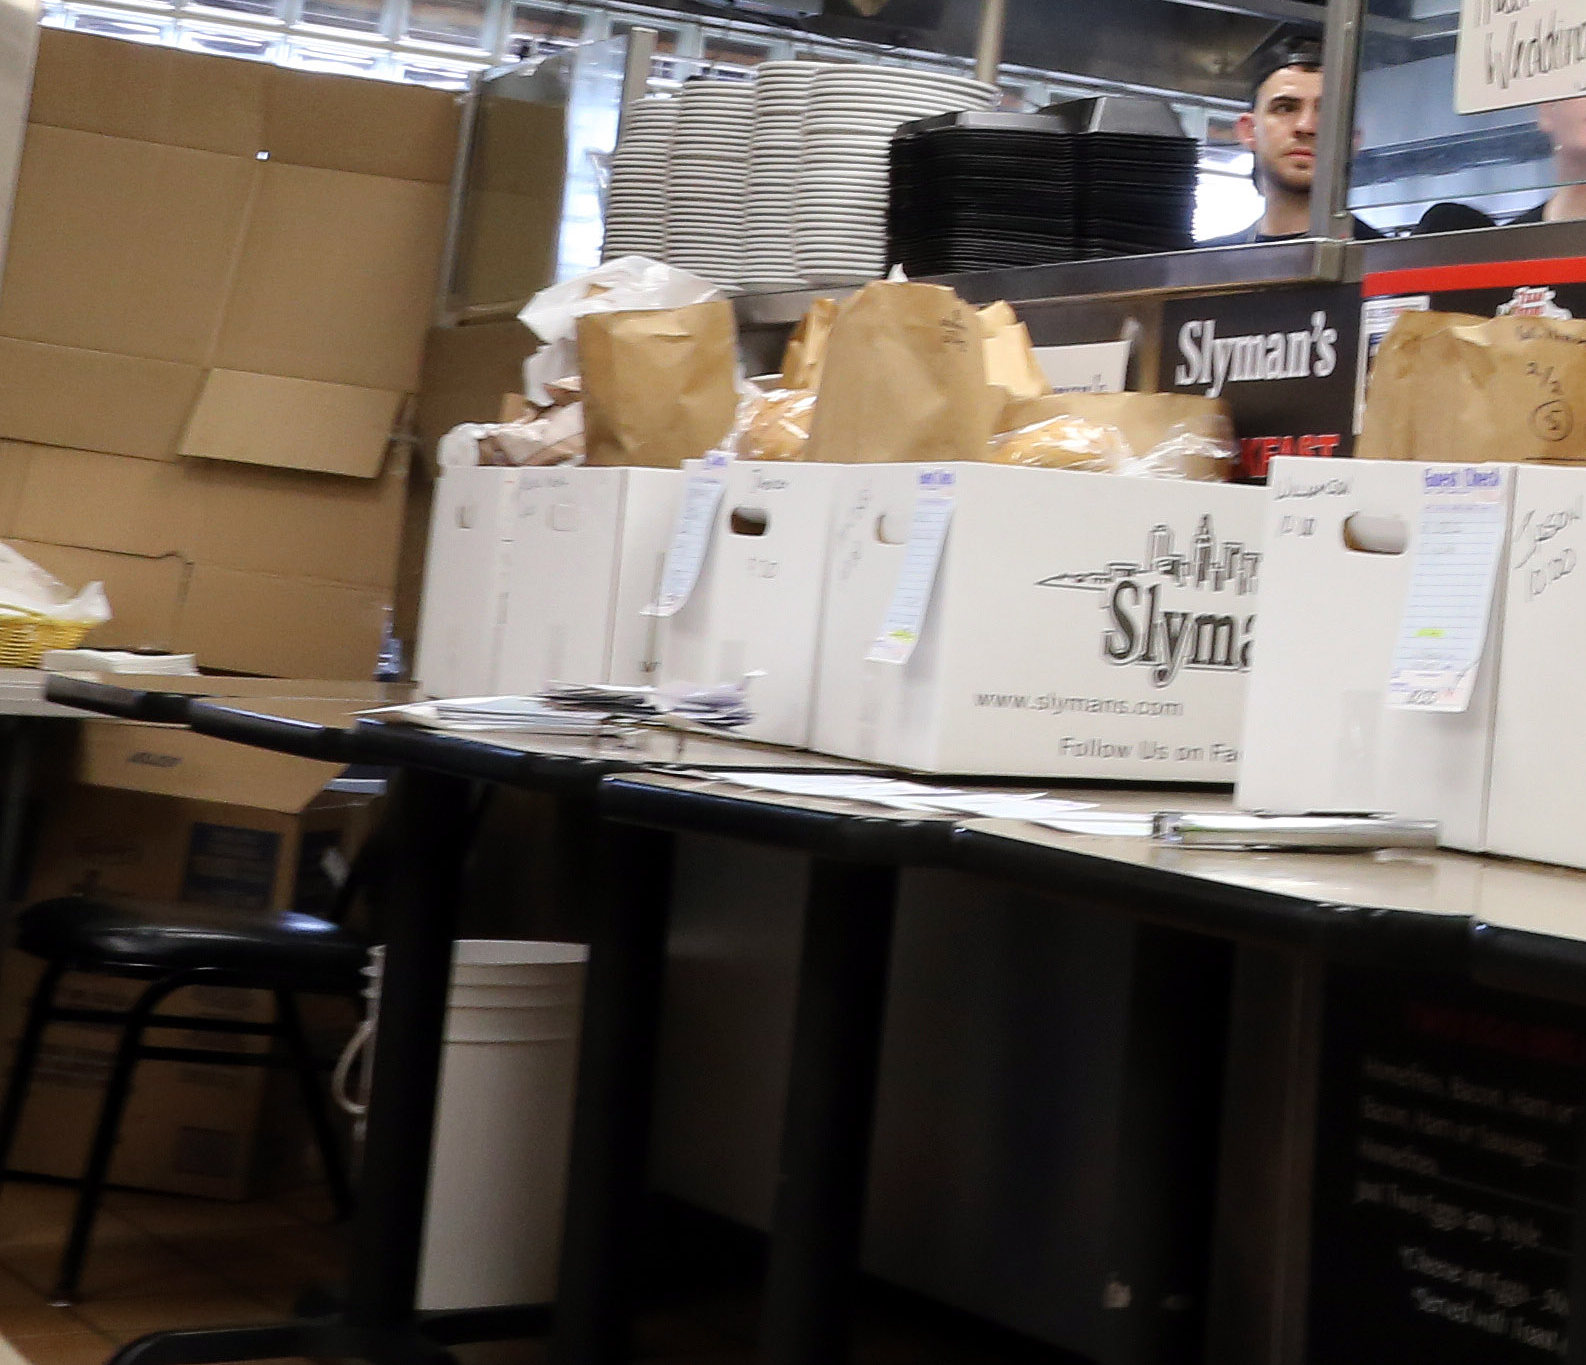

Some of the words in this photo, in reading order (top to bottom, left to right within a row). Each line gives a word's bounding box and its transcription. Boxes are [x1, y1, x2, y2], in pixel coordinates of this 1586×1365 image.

[1174, 310, 1338, 399] Slyman's
[975, 690, 1183, 717] www.slymans.com
[1058, 737, 1131, 761] Follow
[1139, 740, 1169, 762] Us
[1176, 744, 1203, 762] on
